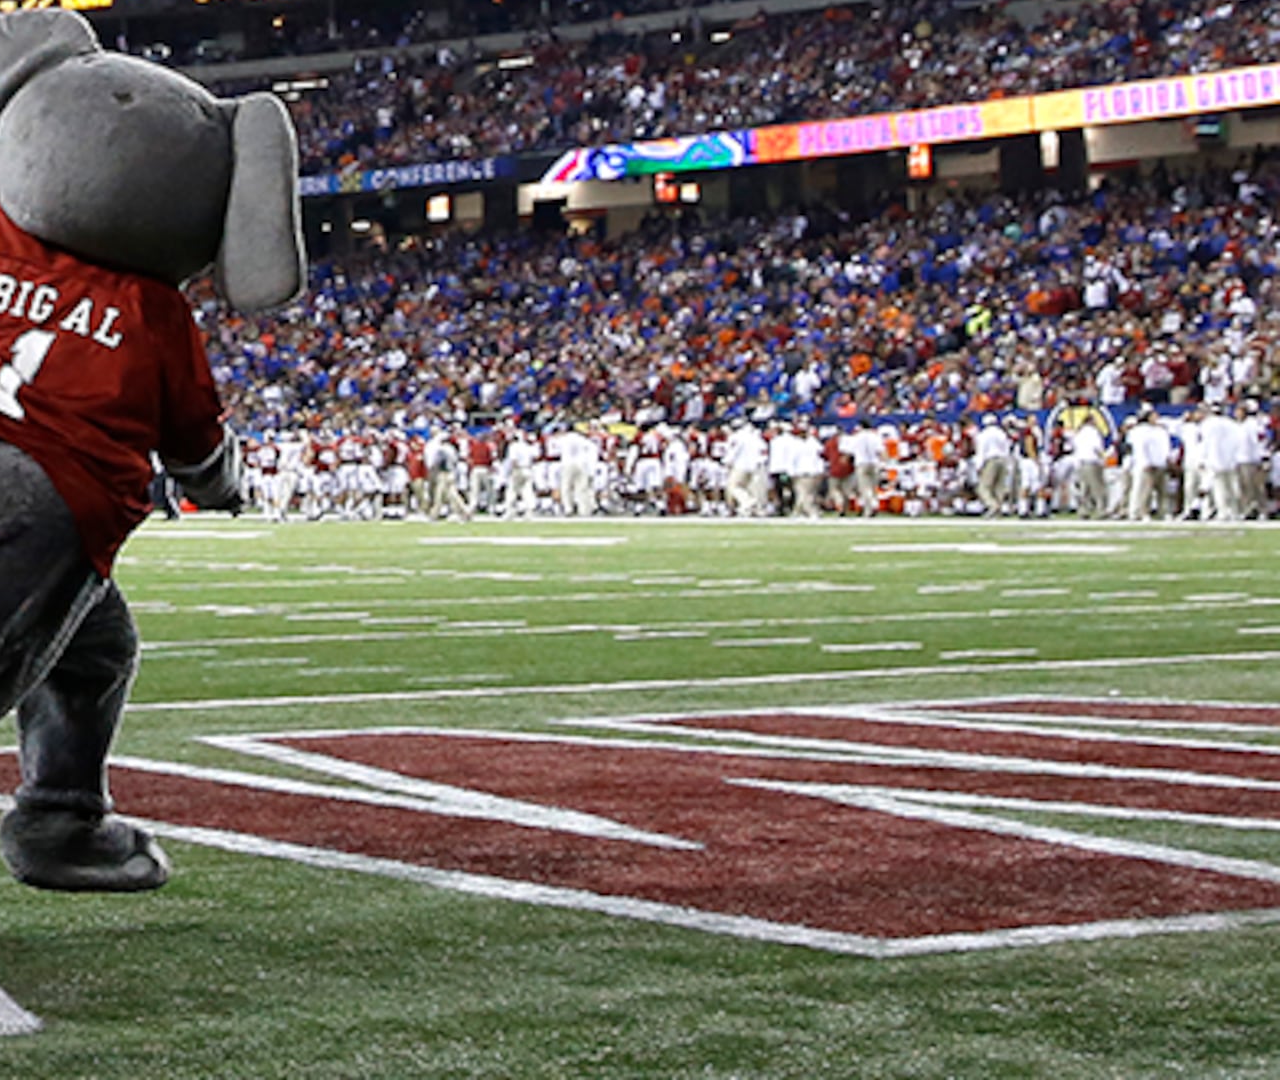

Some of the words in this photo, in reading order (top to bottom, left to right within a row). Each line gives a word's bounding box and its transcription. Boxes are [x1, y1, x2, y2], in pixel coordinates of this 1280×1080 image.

[1084, 82, 1188, 123] FLORIDA
[798, 116, 892, 156] FLORIDA
[897, 106, 985, 144] GATORS
[60, 298, 123, 350] AL
